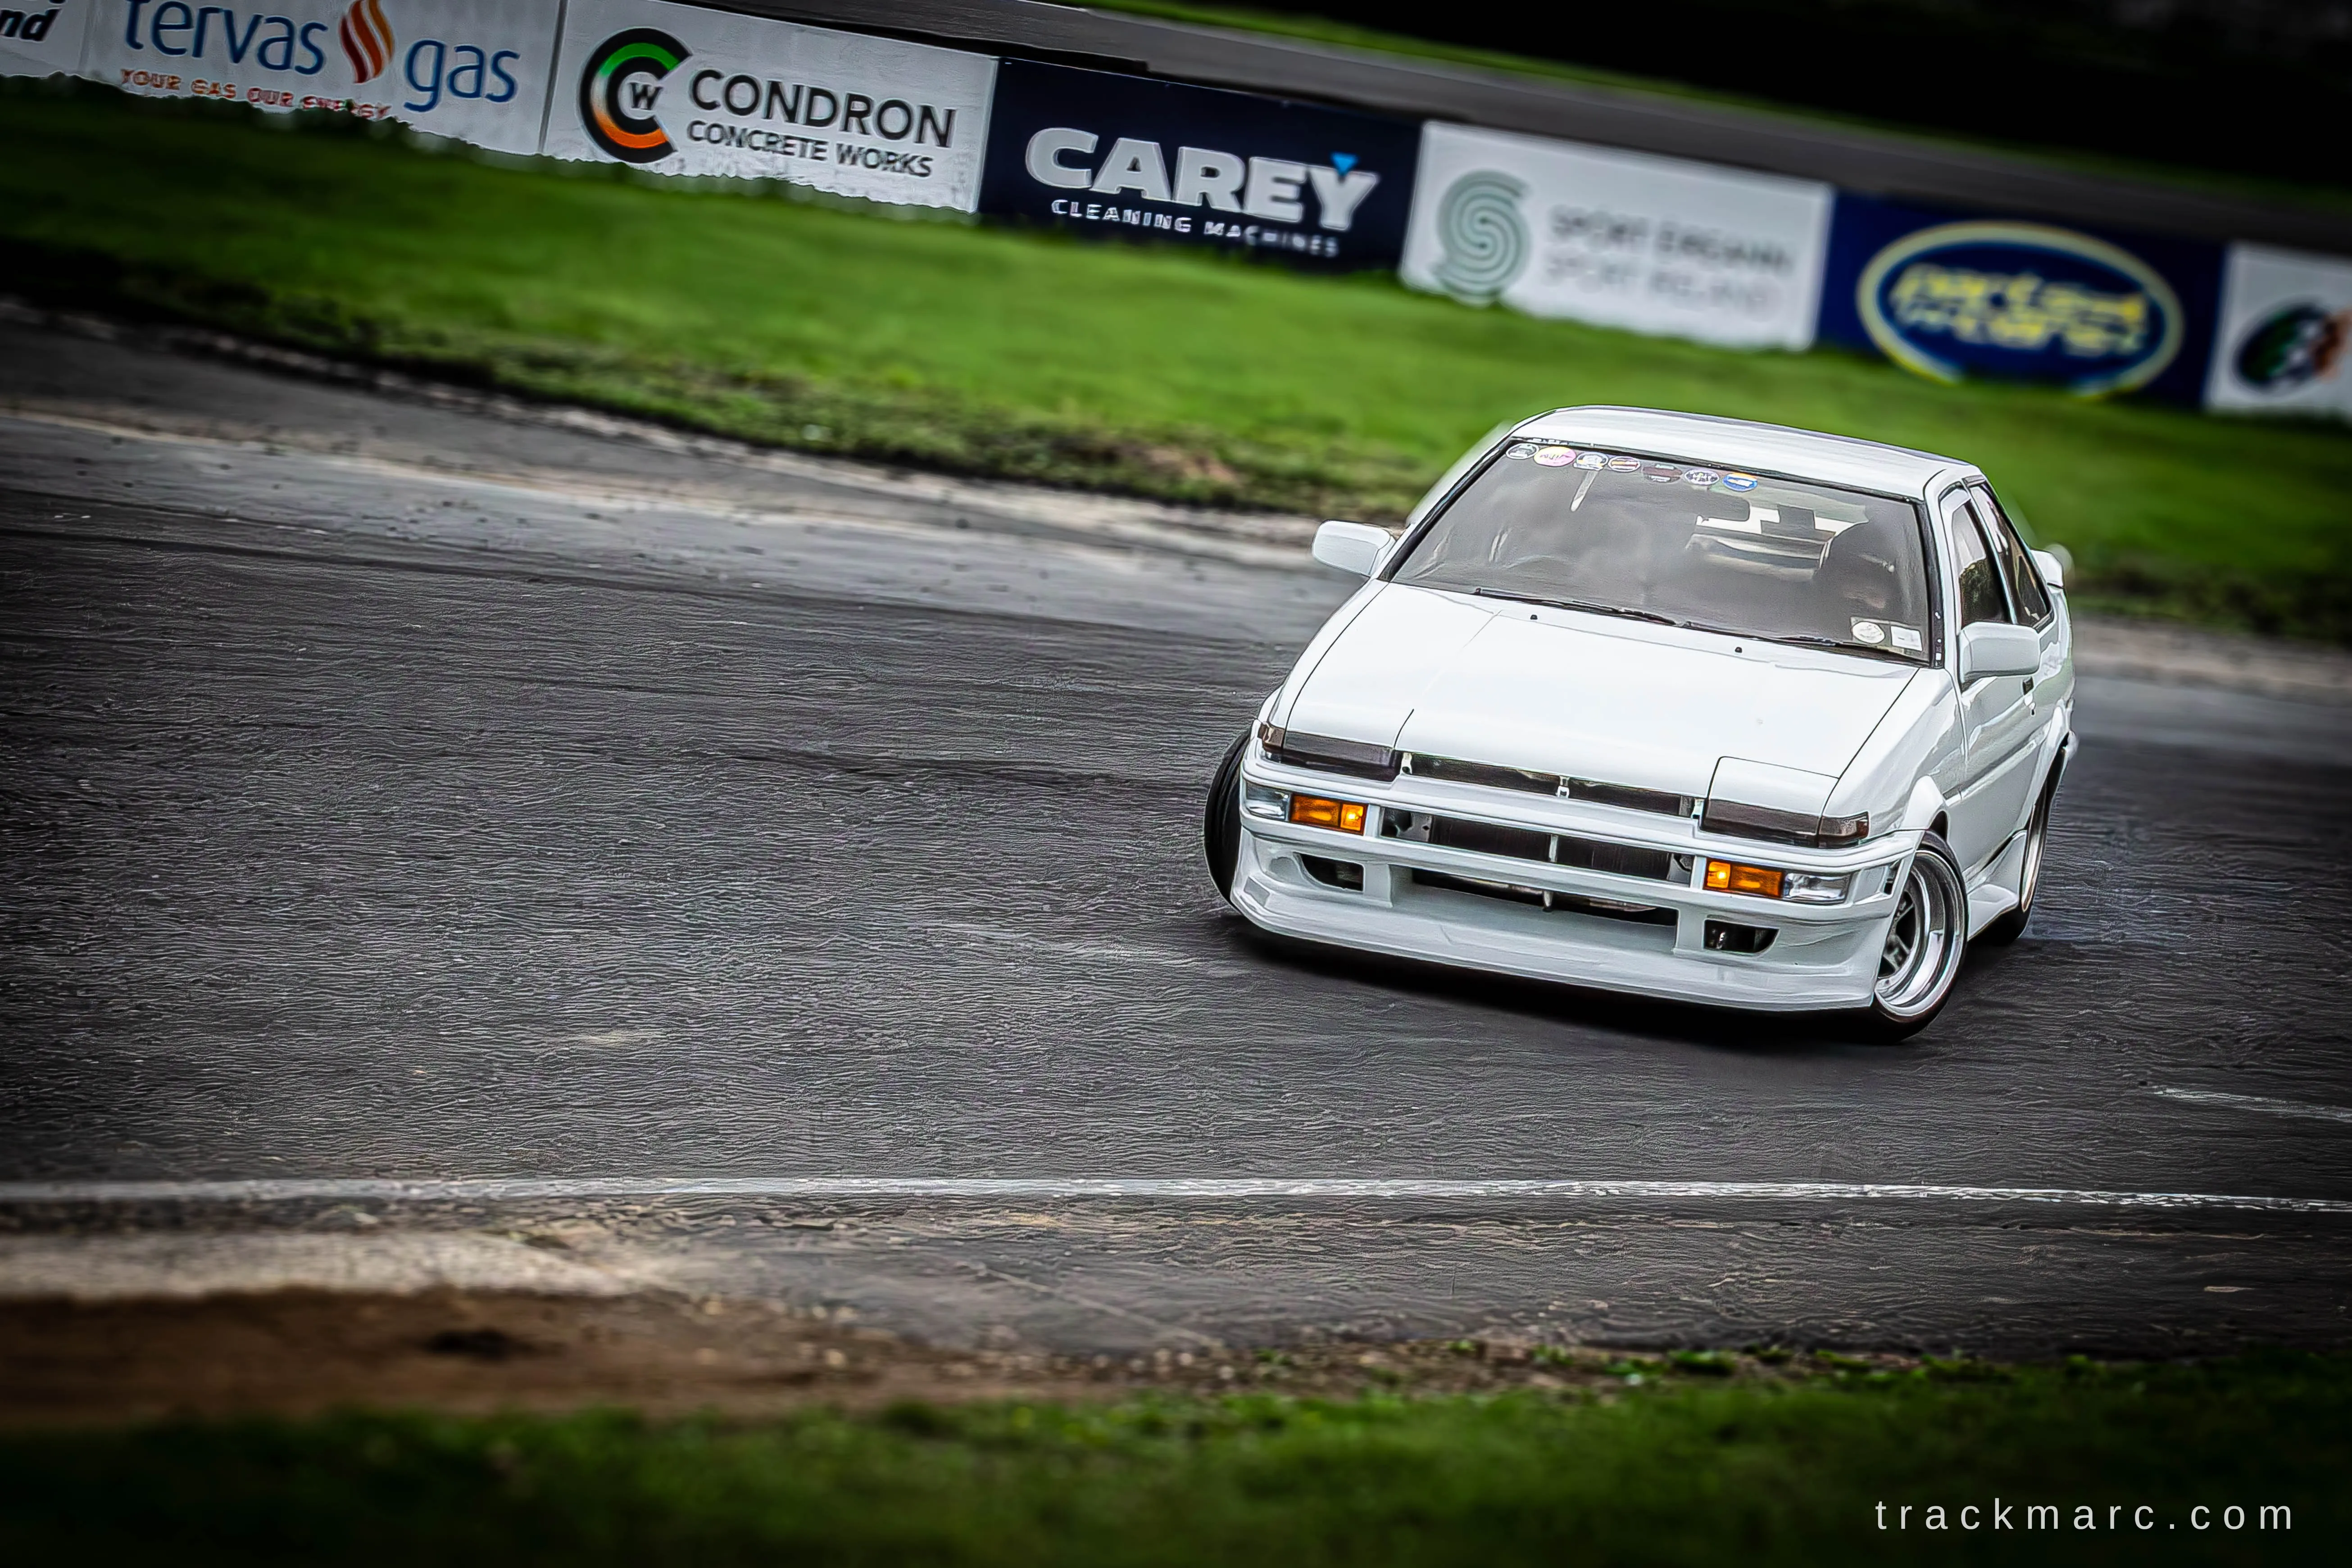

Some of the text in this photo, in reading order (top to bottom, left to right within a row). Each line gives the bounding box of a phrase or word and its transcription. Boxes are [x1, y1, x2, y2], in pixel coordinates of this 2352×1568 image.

[191, 79, 236, 99] GAS
[246, 87, 294, 107] OUR
[404, 39, 520, 112] gas
[690, 68, 957, 148] CONDRON
[687, 120, 934, 177] CONCRETE WORKS
[1026, 127, 1379, 232] CAREY
[1051, 199, 1339, 257] CLEANING MACHINES
